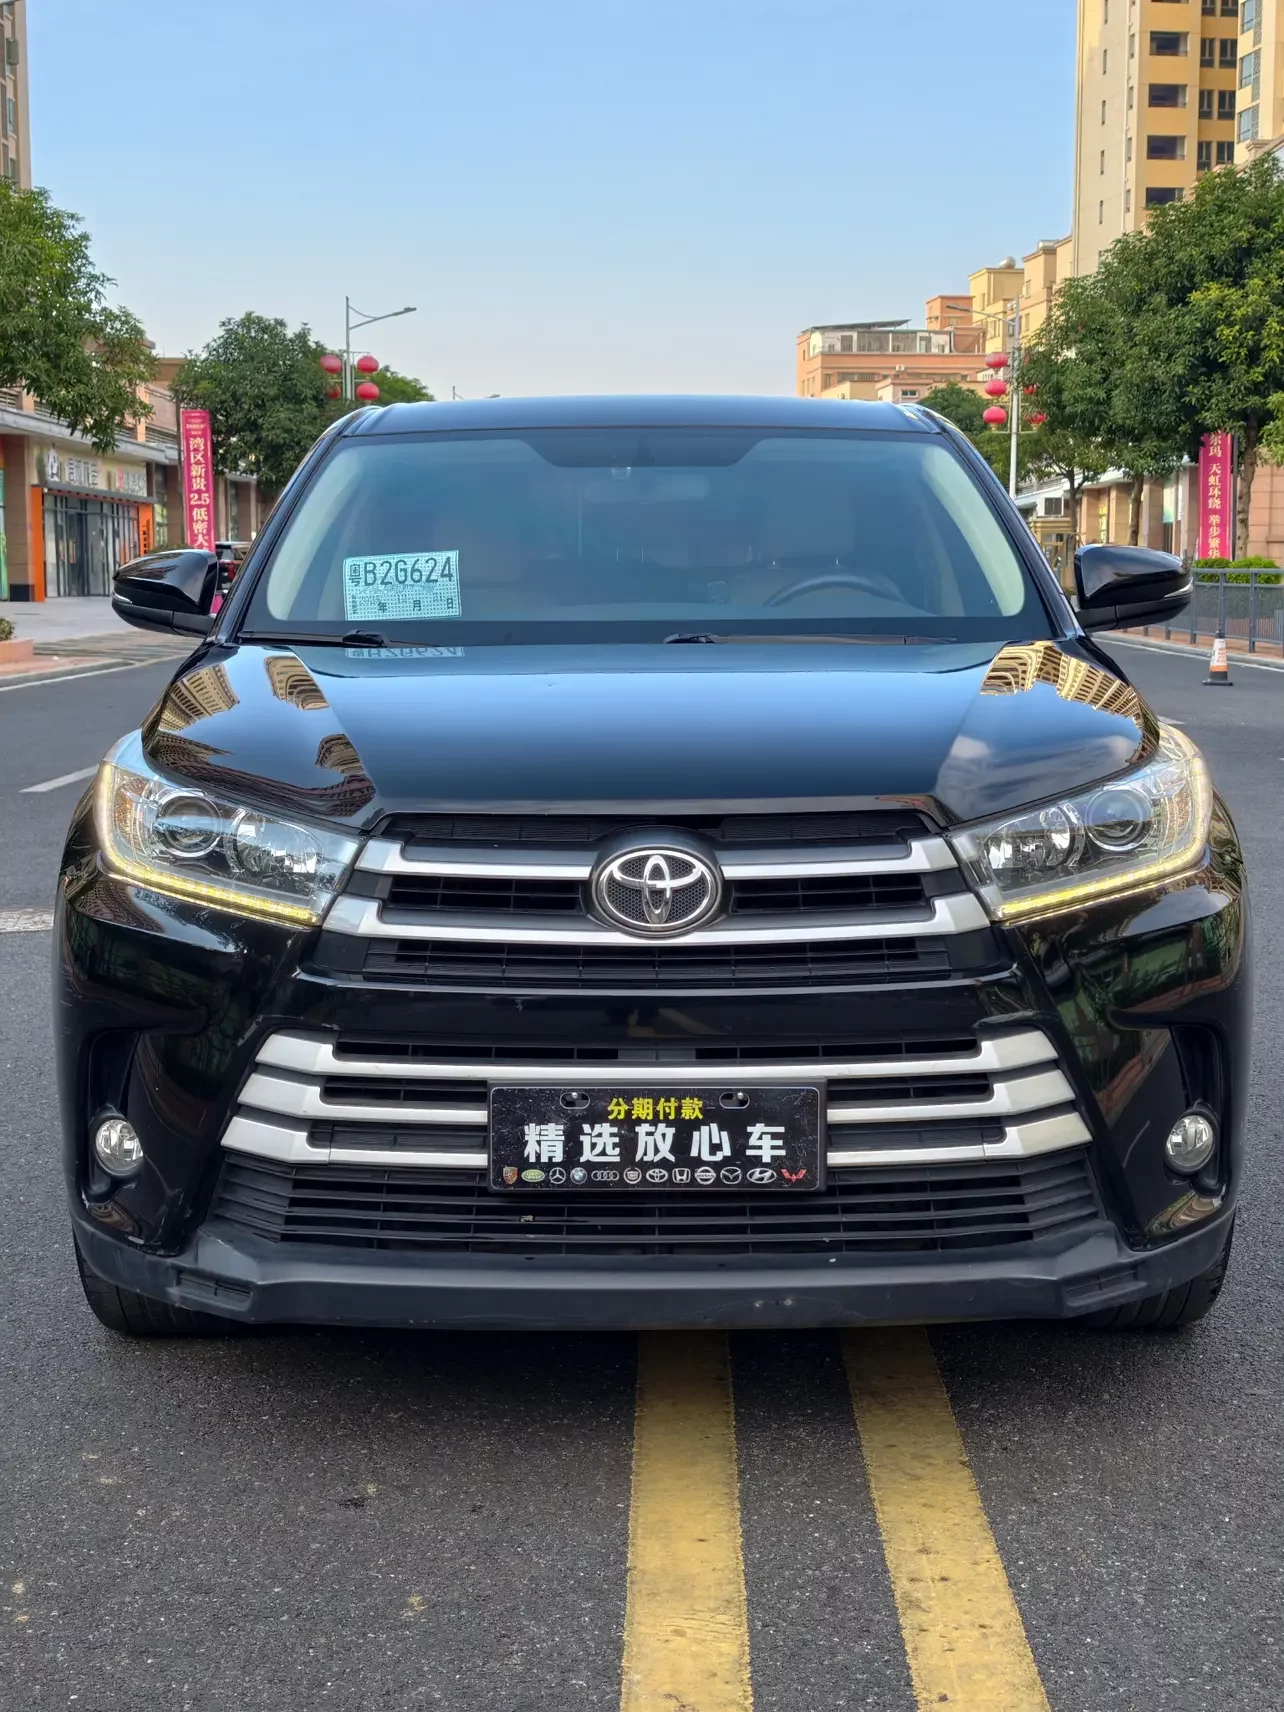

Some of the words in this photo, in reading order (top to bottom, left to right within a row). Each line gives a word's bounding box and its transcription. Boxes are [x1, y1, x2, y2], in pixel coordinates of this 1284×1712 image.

[349, 556, 454, 588] 粤B2G624
[412, 600, 422, 611] 月
[446, 597, 454, 609] 日
[607, 1097, 704, 1121] 分期付款
[523, 1122, 787, 1164] 精选放心车
